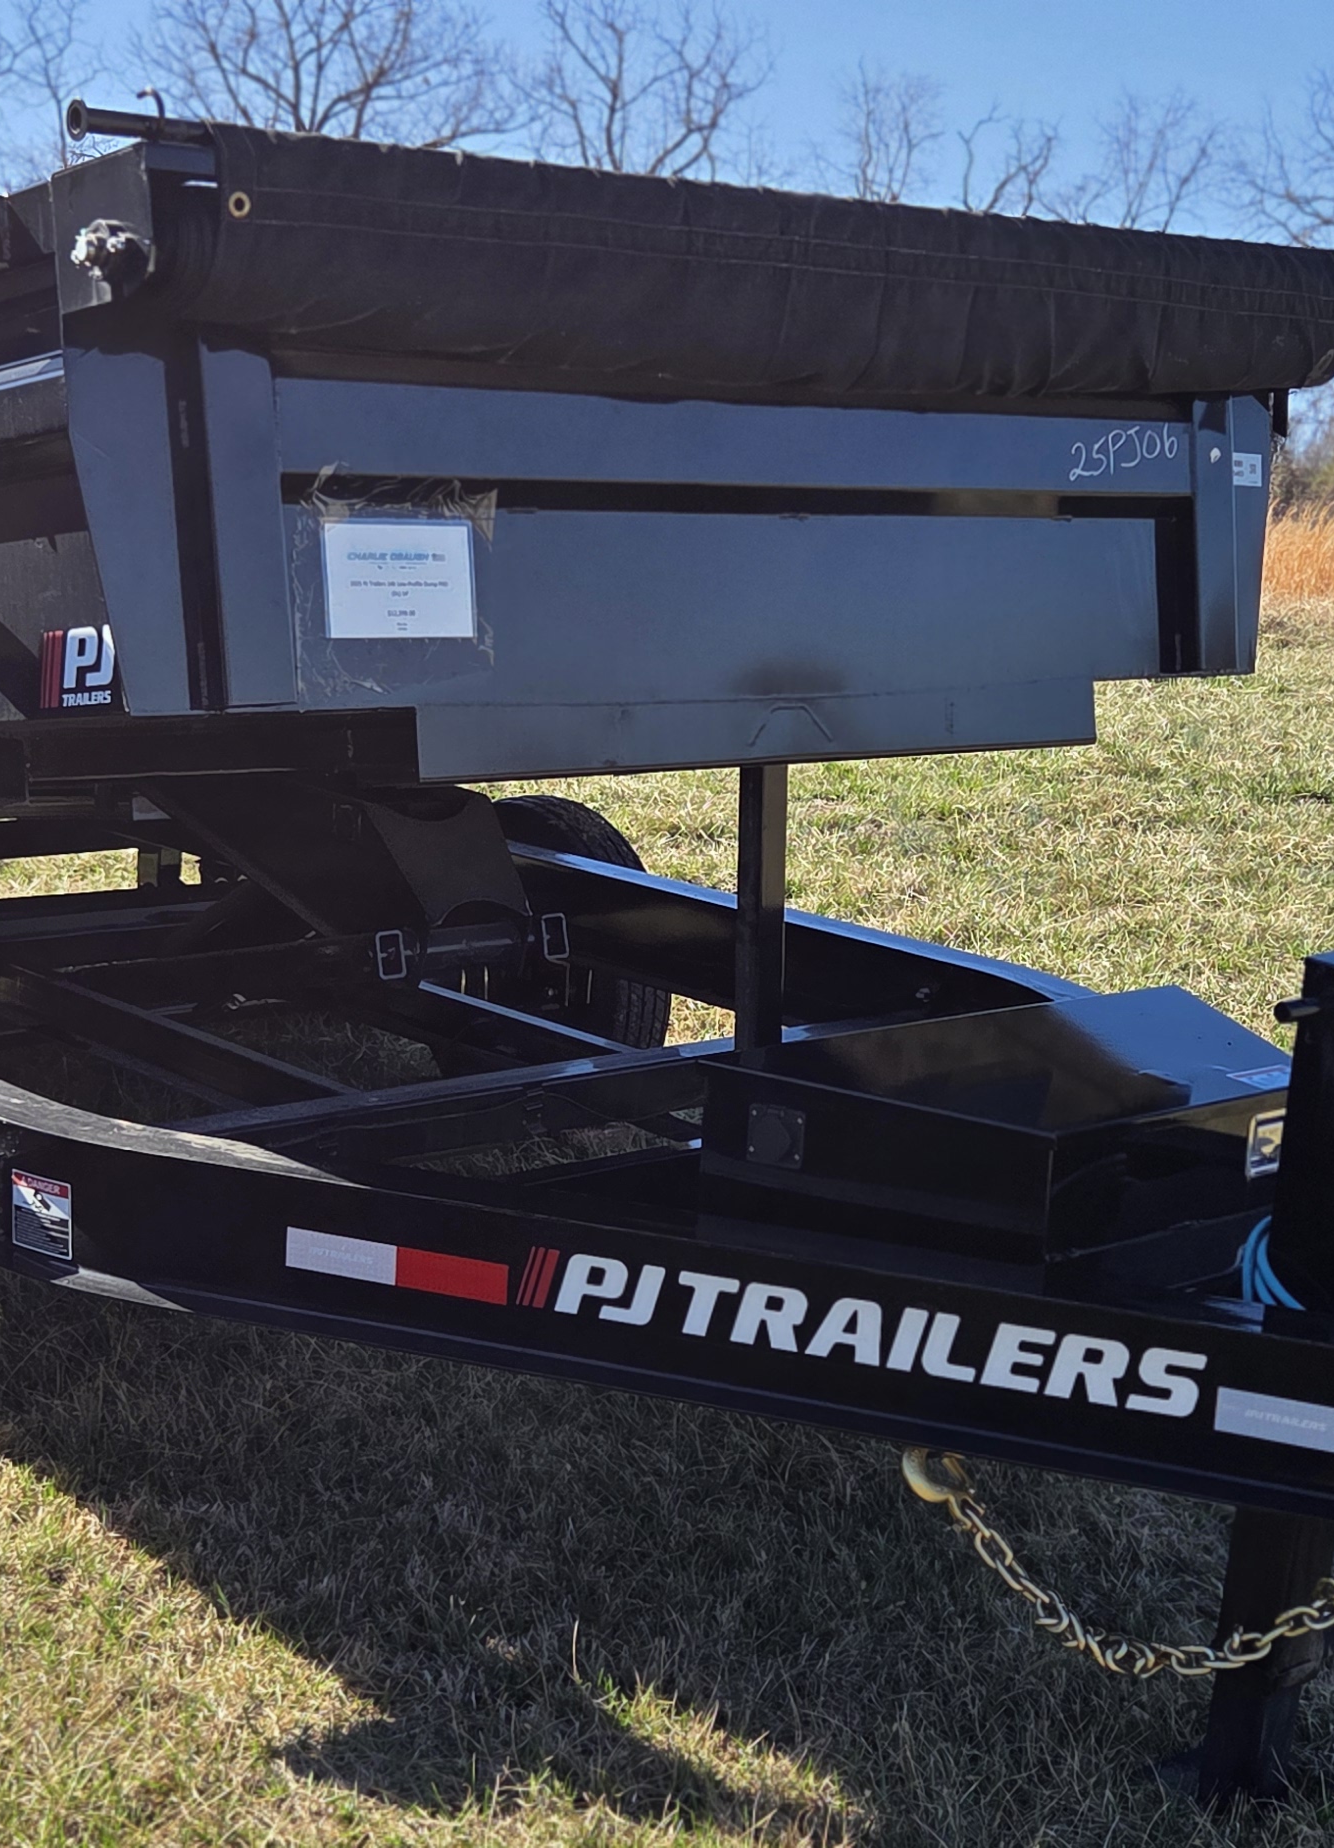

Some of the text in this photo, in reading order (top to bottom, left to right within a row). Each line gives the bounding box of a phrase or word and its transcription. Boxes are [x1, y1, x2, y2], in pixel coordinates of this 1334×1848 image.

[1069, 422, 1178, 482] 25PJ06
[63, 624, 115, 689] PJ
[62, 690, 111, 707] TRAILERS
[27, 1177, 61, 1195] DANGER
[554, 1253, 1208, 1418] PJ TRAILERS
